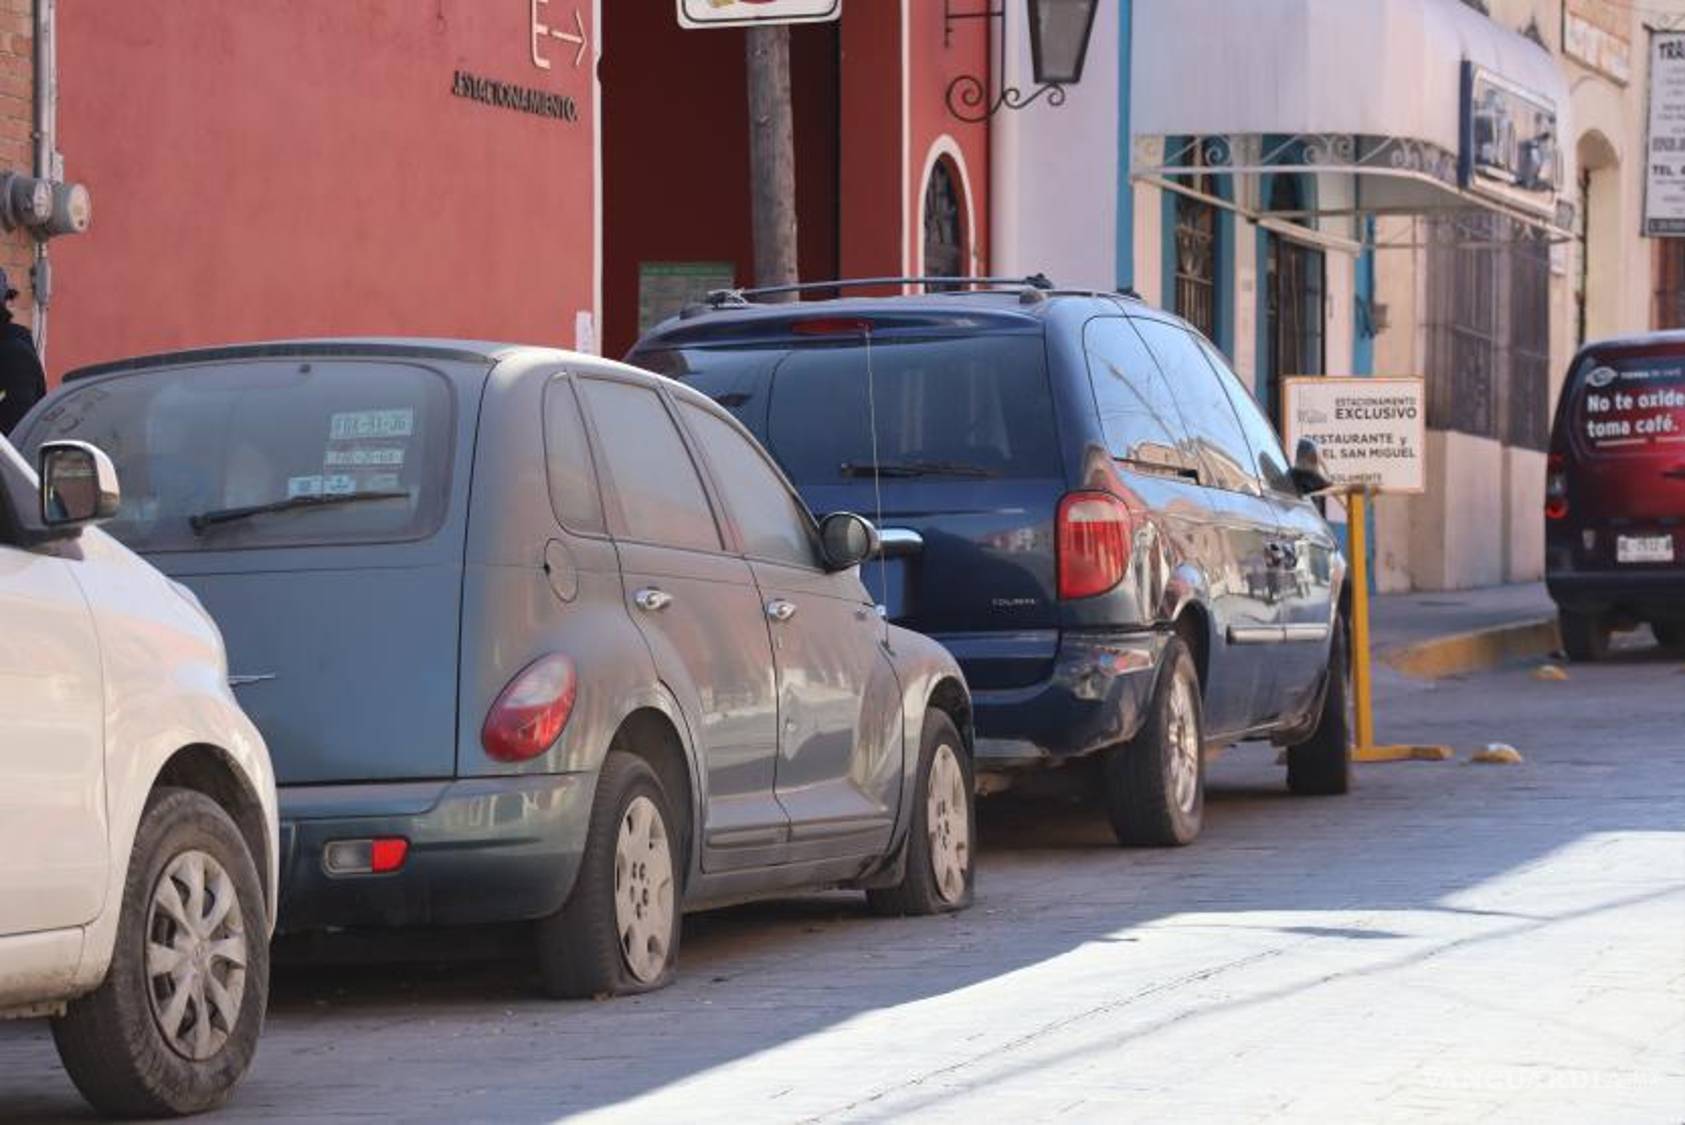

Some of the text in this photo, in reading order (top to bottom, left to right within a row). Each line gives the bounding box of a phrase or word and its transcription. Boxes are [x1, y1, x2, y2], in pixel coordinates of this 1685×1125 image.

[1335, 397, 1416, 406] ESTACIONAMIENTO
[1587, 394, 1610, 412] No
[1615, 392, 1633, 410] te
[1335, 407, 1417, 419] EXCLUSIVO
[1587, 414, 1679, 438] toma café.
[1340, 448, 1367, 459] SAN
[1369, 447, 1416, 459] MIGUEL
